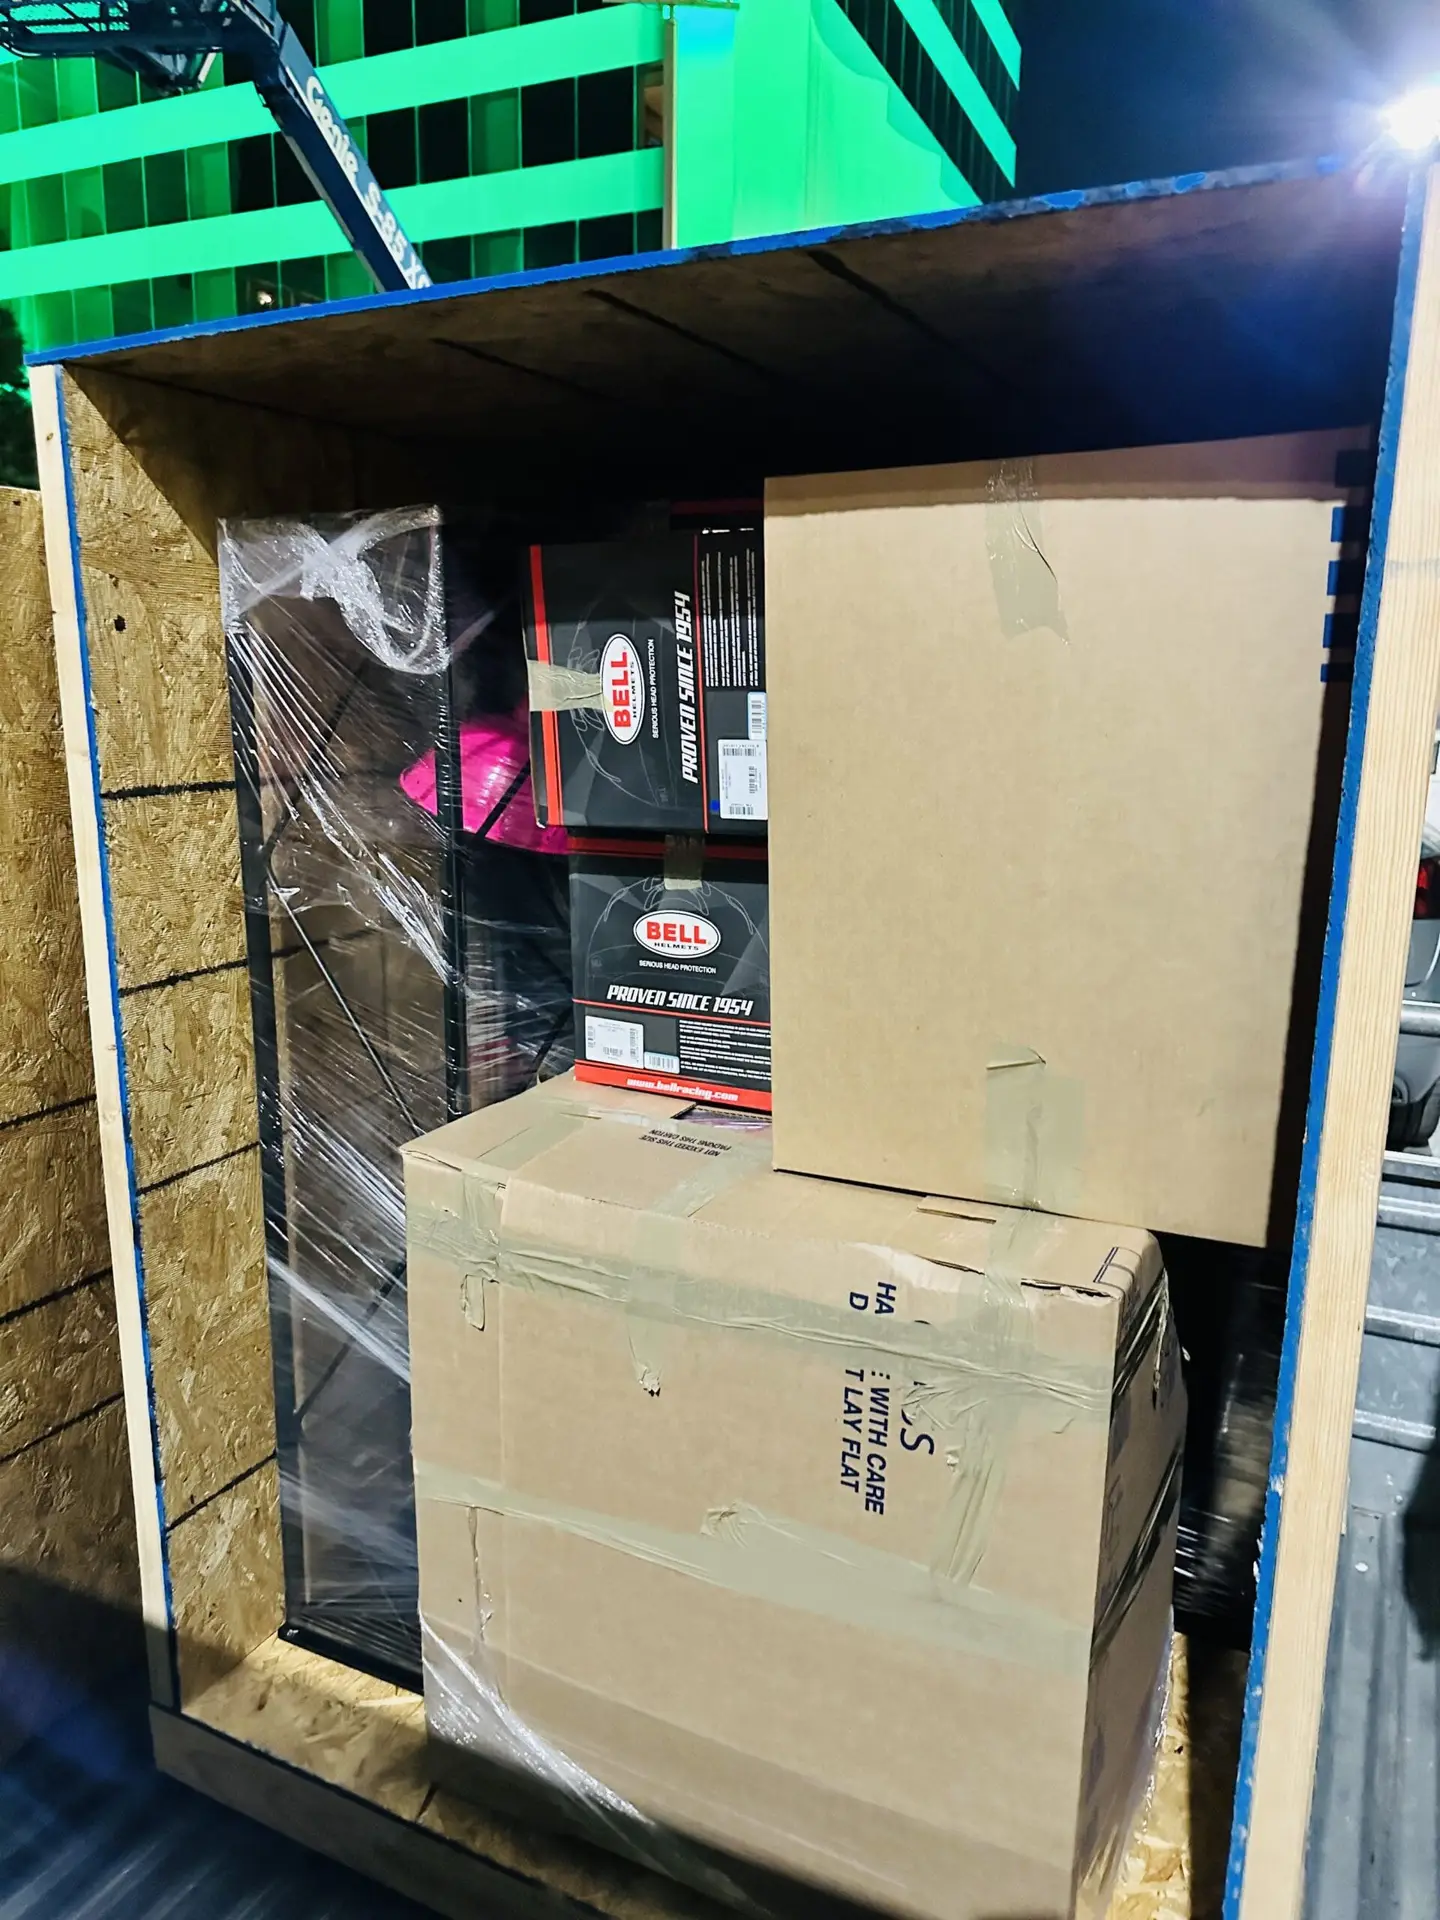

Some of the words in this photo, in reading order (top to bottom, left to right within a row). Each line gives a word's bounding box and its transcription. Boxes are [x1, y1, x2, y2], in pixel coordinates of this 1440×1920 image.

[306, 76, 359, 180] Genie
[365, 182, 408, 261] S-85
[674, 590, 693, 644] 1954
[648, 638, 657, 685] PROTECTION
[677, 643, 696, 704] SINCE
[610, 651, 632, 728] BELL
[650, 684, 658, 706] HEAD
[651, 706, 660, 739] SERIOUS
[679, 702, 699, 784] PROVEN
[646, 921, 707, 945] BELL
[654, 942, 699, 951] HELMETS
[639, 959, 663, 969] SERIOUS
[664, 962, 680, 971] HEAD
[680, 964, 717, 974] PROTECTION
[607, 984, 667, 1006] PROVEN
[666, 991, 712, 1012] SINCE
[713, 996, 754, 1017] 1954
[626, 1078, 739, 1101] www.bellracing.com
[843, 1386, 864, 1434] LAY
[868, 1386, 890, 1447] WITH
[840, 1437, 861, 1494] FLAT
[864, 1453, 887, 1515] CARE
